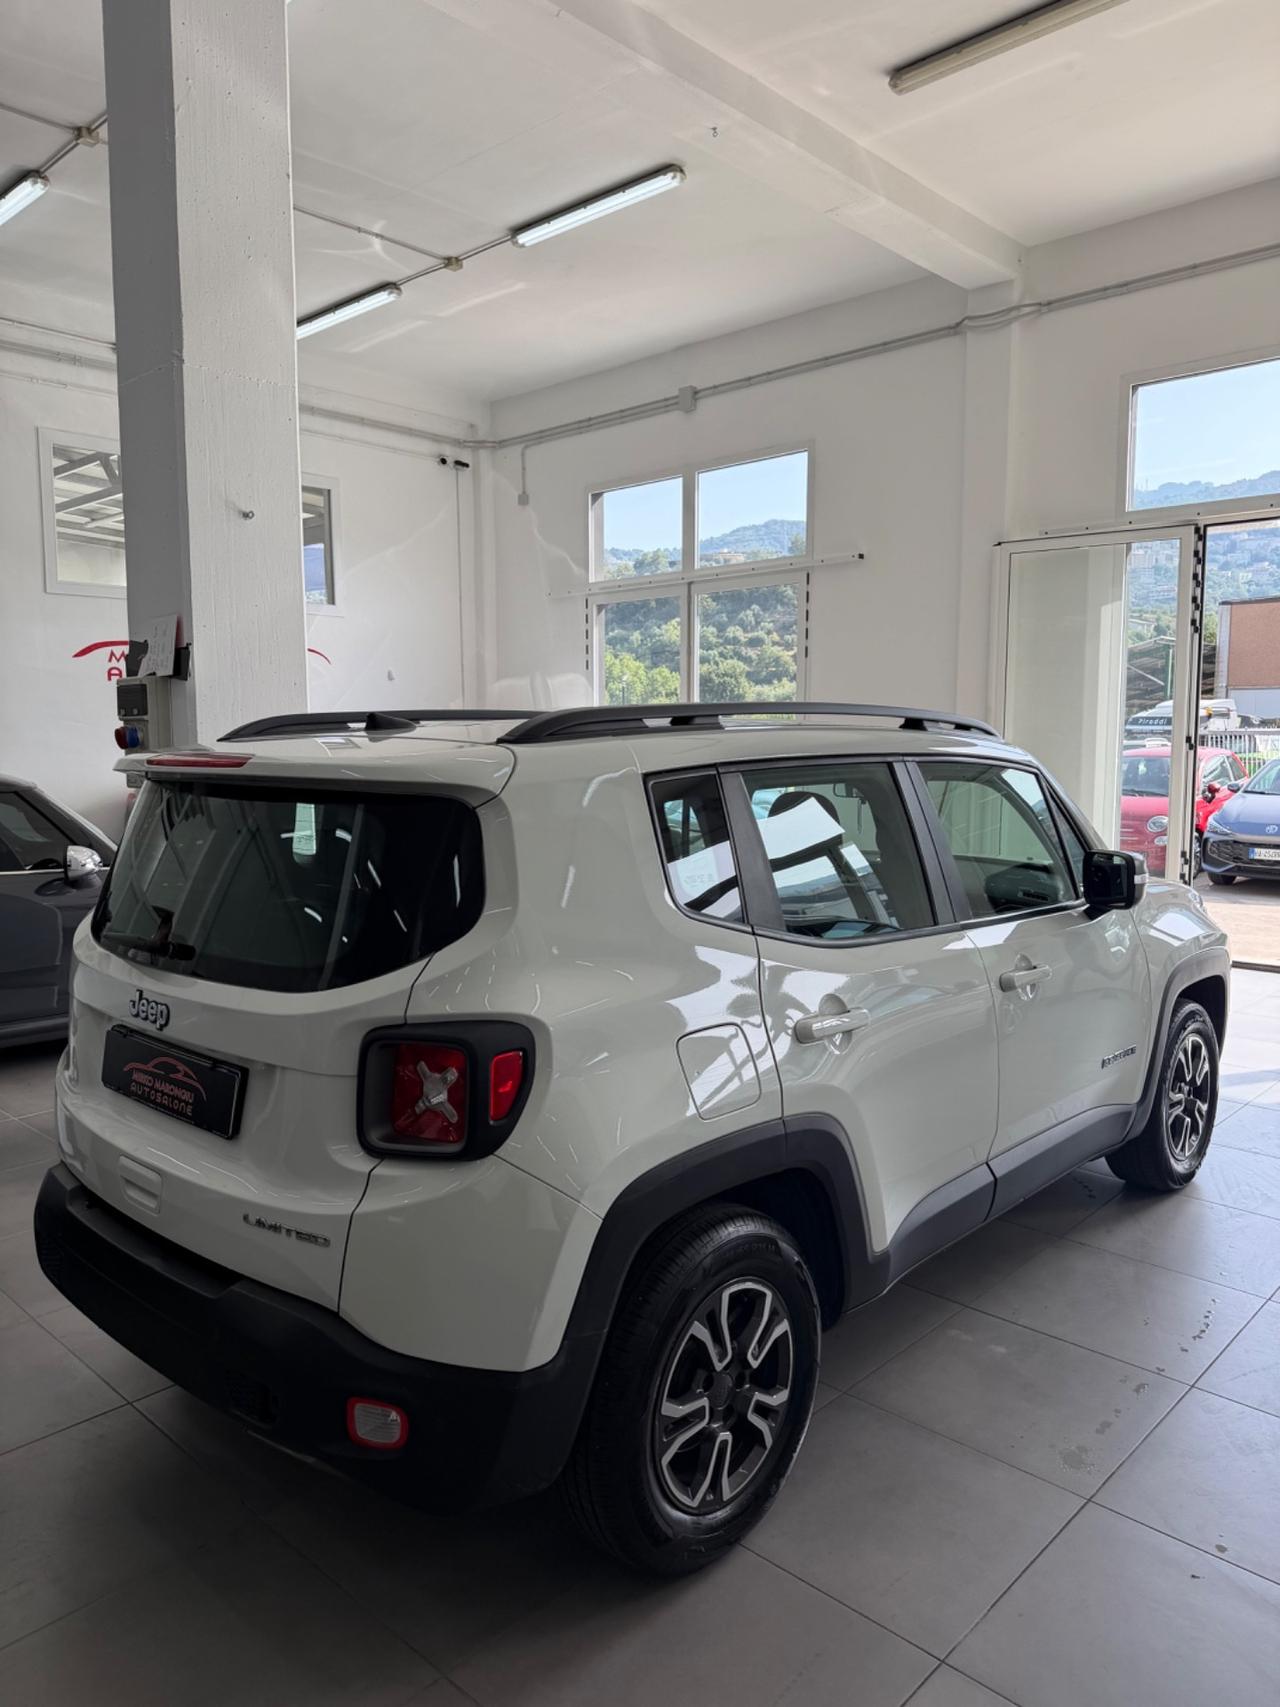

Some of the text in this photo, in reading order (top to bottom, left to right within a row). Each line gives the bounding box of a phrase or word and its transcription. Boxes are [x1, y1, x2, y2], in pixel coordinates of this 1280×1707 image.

[129, 989, 170, 1031] Jeep
[130, 1083, 193, 1116] AUTOSALONE
[243, 1213, 331, 1248] LIMITED
